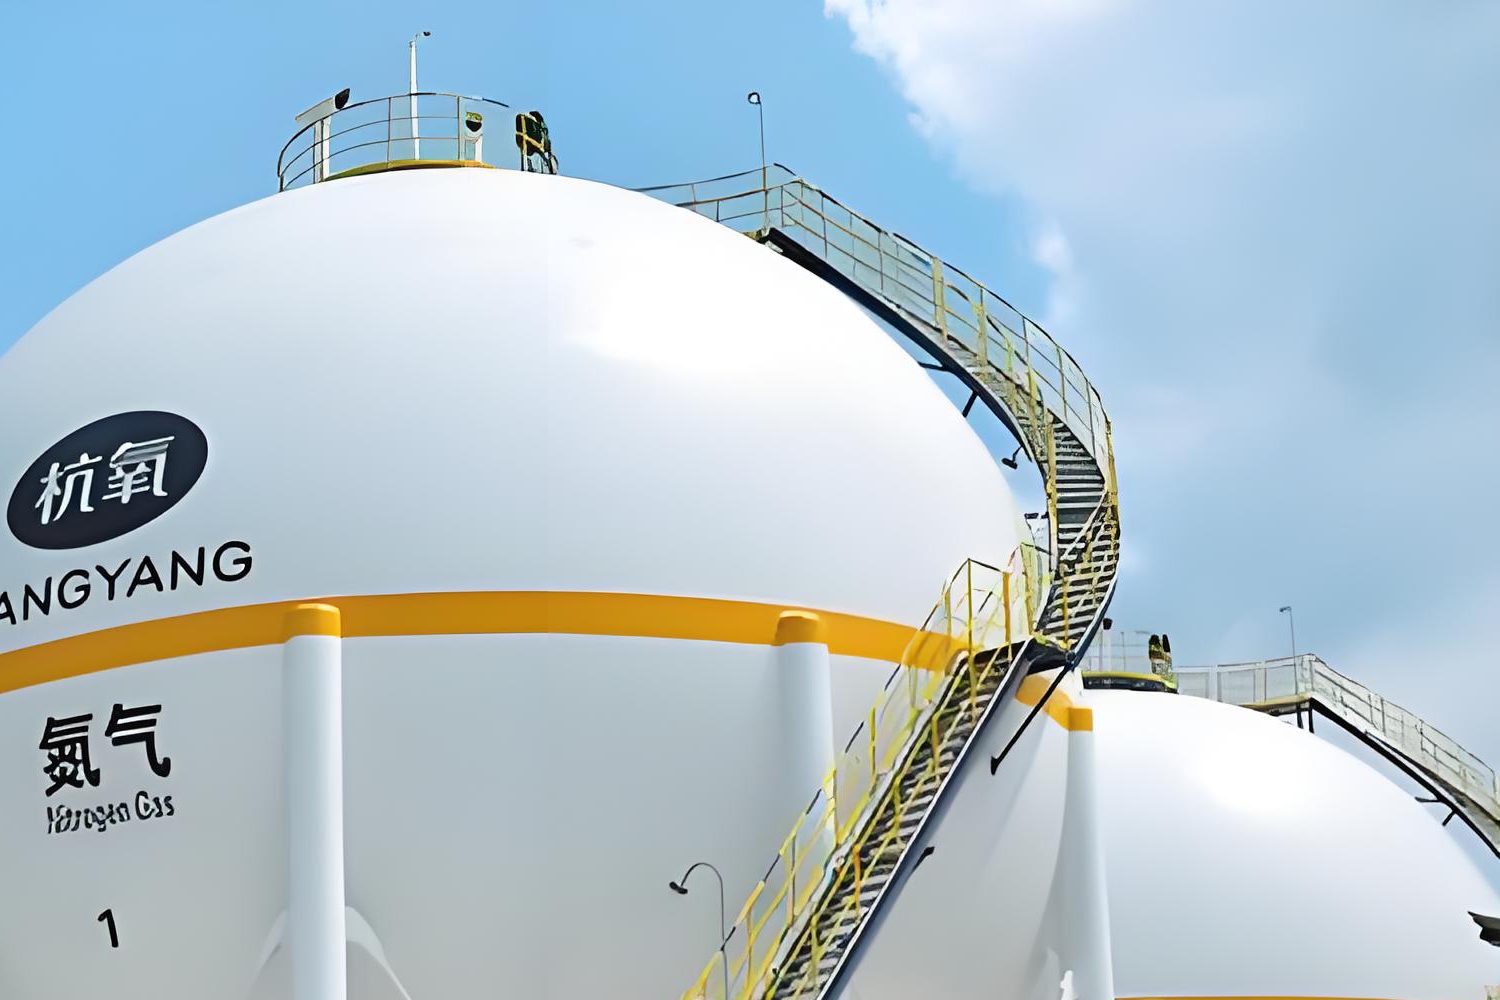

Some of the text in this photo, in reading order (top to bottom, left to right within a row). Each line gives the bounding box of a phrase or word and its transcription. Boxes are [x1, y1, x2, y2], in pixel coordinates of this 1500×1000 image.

[34, 434, 176, 526] 杭氧
[38, 703, 172, 797] 氮气
[97, 908, 120, 948] 1
